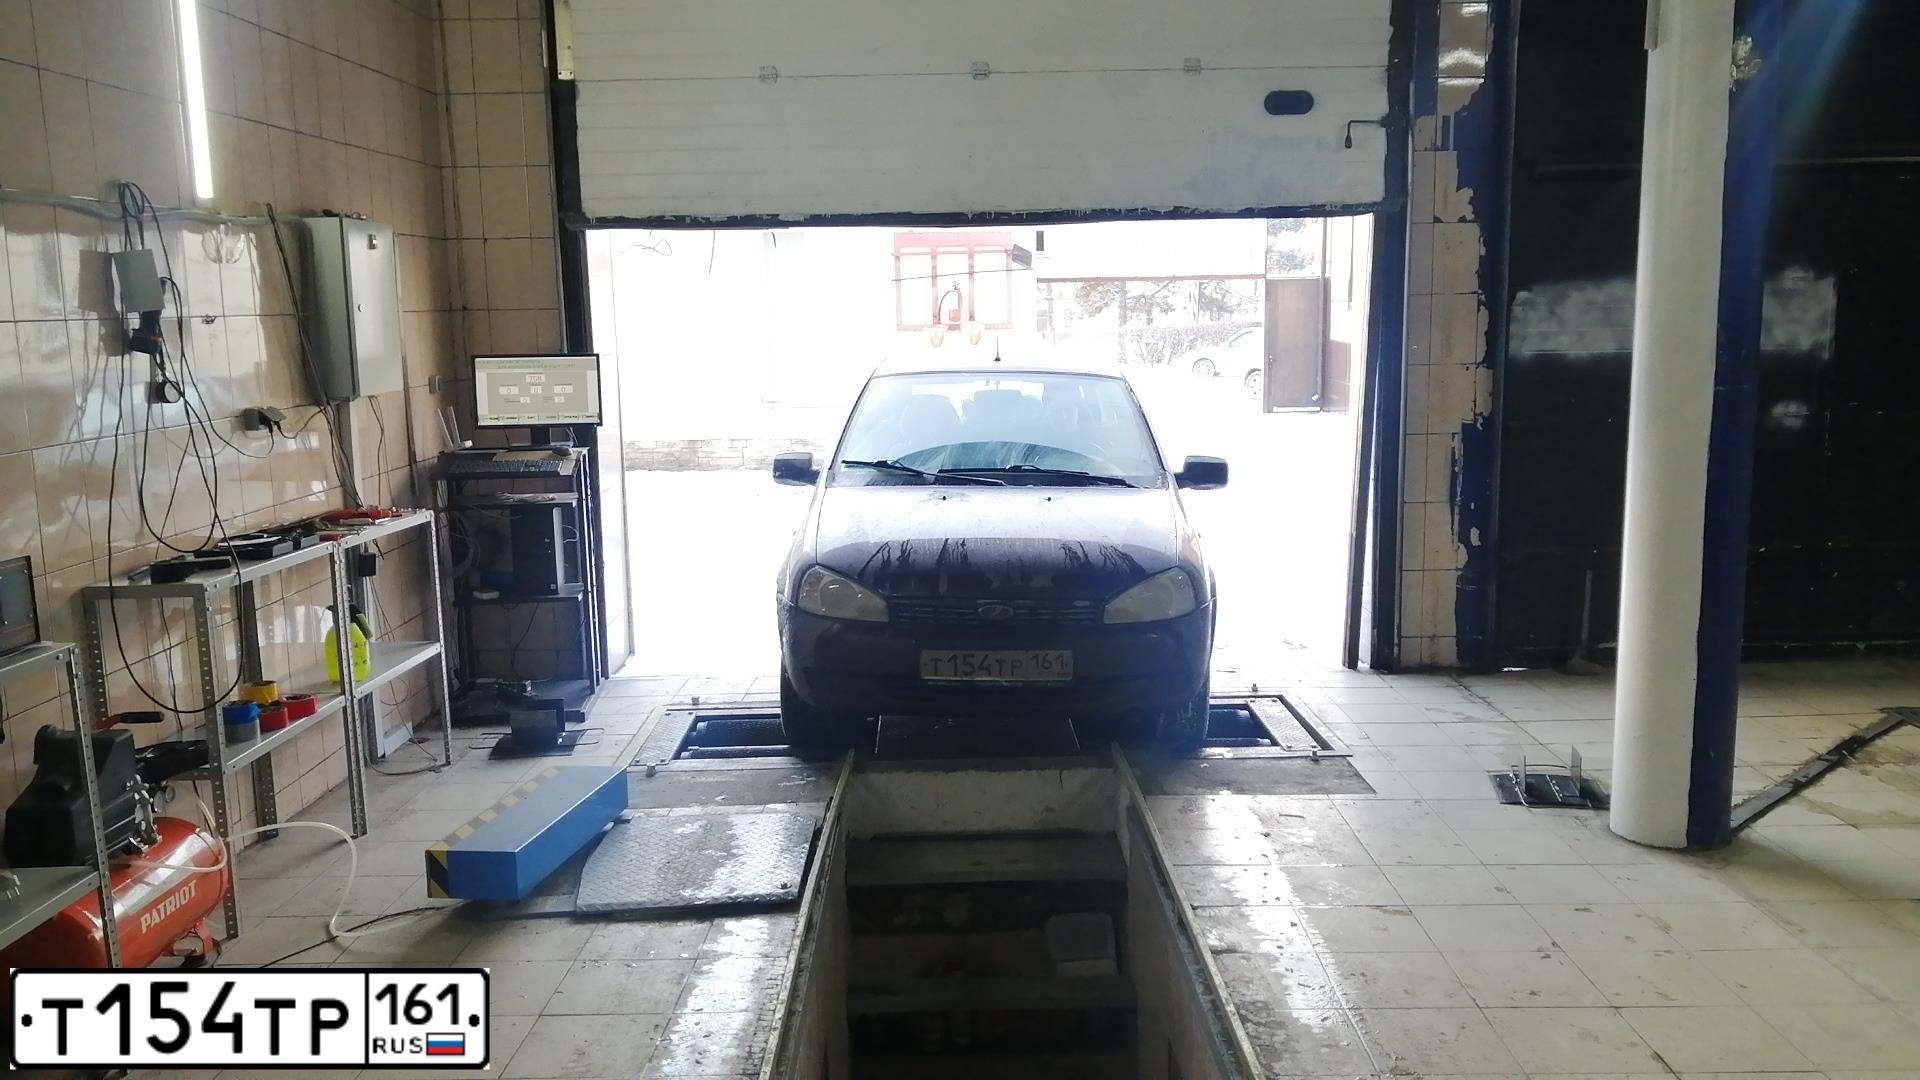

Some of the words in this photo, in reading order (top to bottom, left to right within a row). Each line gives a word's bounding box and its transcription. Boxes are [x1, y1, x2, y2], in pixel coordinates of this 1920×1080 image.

[930, 653, 1023, 676] Т154ТР
[1030, 653, 1065, 670] 161
[139, 880, 198, 934] PATRIOT
